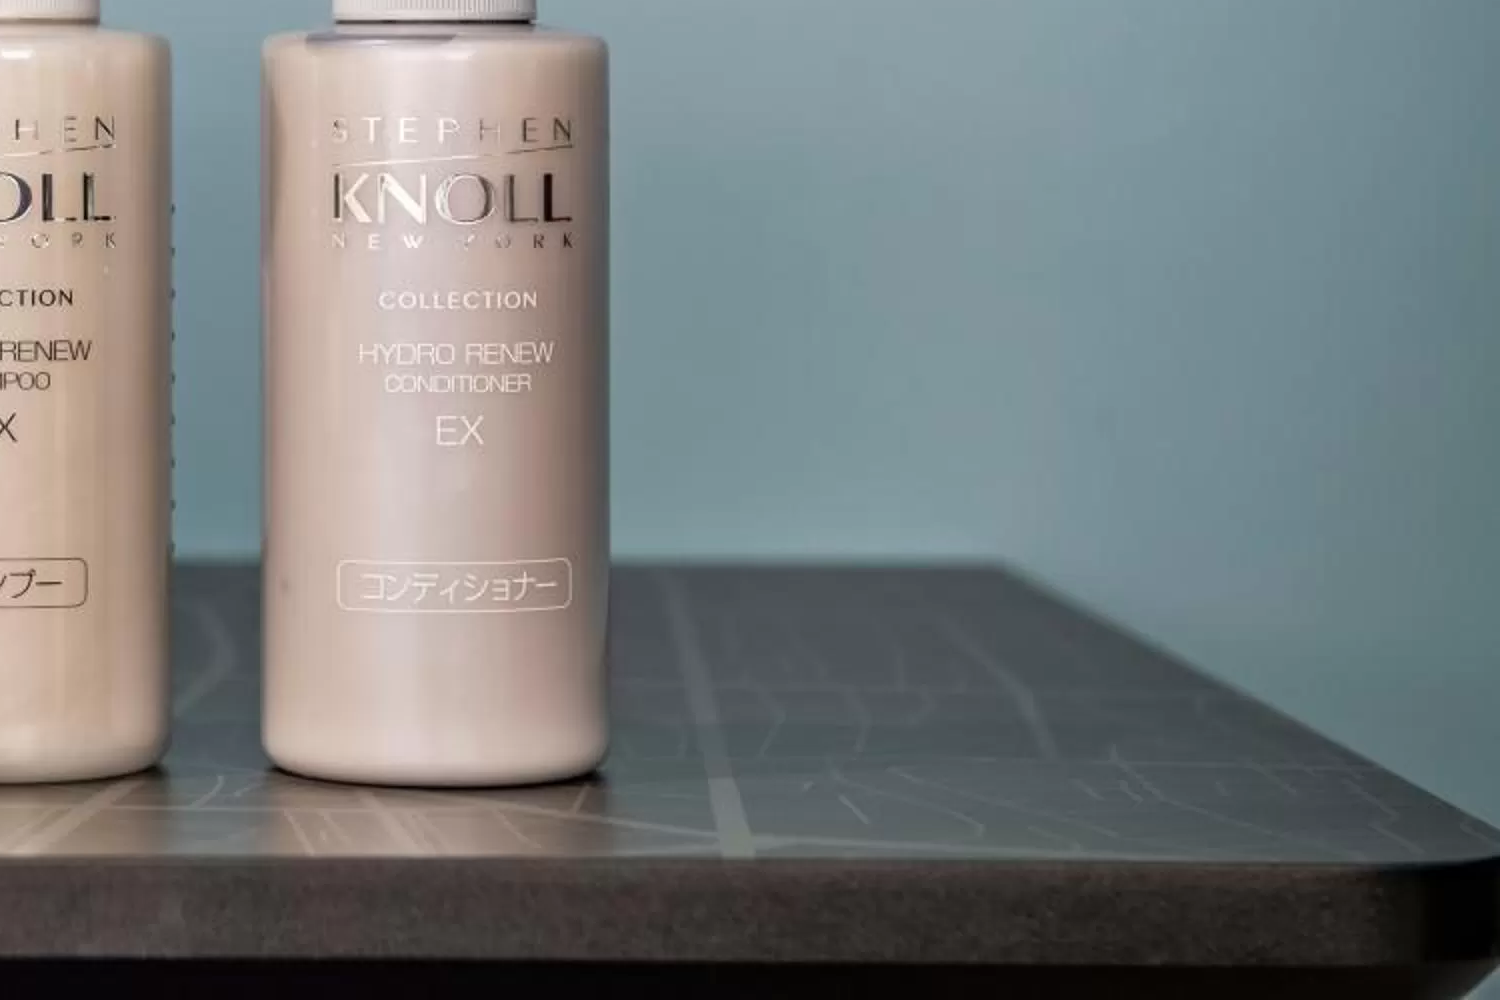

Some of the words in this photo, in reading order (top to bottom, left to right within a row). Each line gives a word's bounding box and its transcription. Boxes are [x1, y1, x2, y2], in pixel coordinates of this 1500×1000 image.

[331, 116, 574, 144] STEPHEN
[332, 172, 574, 225] KNOLL
[331, 232, 424, 249] NEW
[379, 290, 538, 310] COLLECTION
[0, 339, 93, 362] RENEW
[358, 343, 455, 365] HYDRO
[465, 341, 555, 365] RENEW
[384, 373, 533, 393] CONDITIONER
[435, 415, 485, 446] EX
